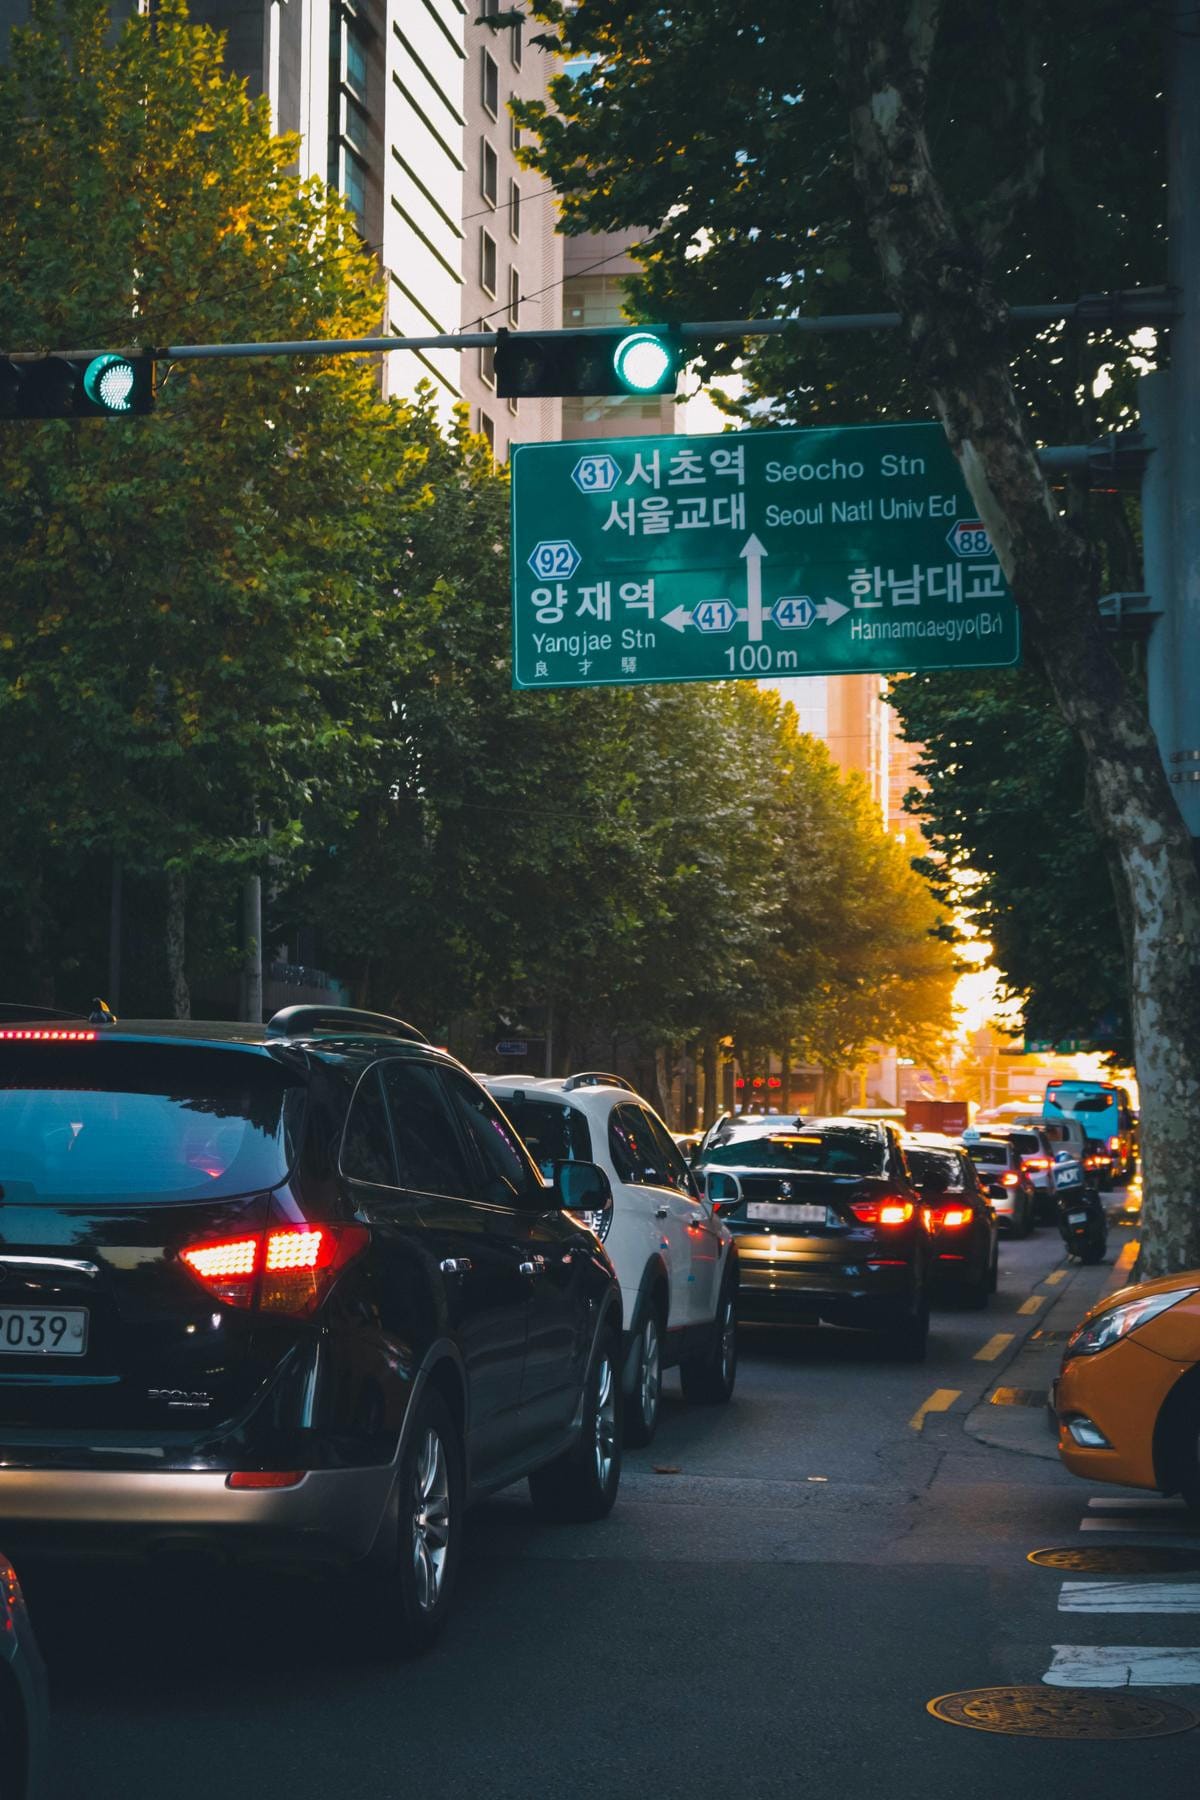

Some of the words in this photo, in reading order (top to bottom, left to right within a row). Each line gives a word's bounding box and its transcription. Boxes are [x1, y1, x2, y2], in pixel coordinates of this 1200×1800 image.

[583, 461, 609, 486] 31
[625, 445, 745, 489] 서초역
[765, 458, 865, 483] Seocho
[881, 454, 925, 477] Stn
[601, 492, 746, 536] 서울교대
[765, 502, 823, 527] Seoul
[832, 499, 873, 523] Natl
[880, 497, 924, 521] Univ
[929, 494, 957, 517] Ed
[960, 531, 988, 552] 88
[541, 548, 569, 573] 92
[848, 562, 1005, 609] 한남대교
[530, 578, 655, 624] 양재역
[780, 601, 806, 623] 41
[702, 605, 726, 628] 41
[532, 631, 612, 657] Yangjae
[621, 628, 656, 650] Stn
[1056, 1168, 1079, 1186] ADT
[0, 1315, 68, 1347] 039
